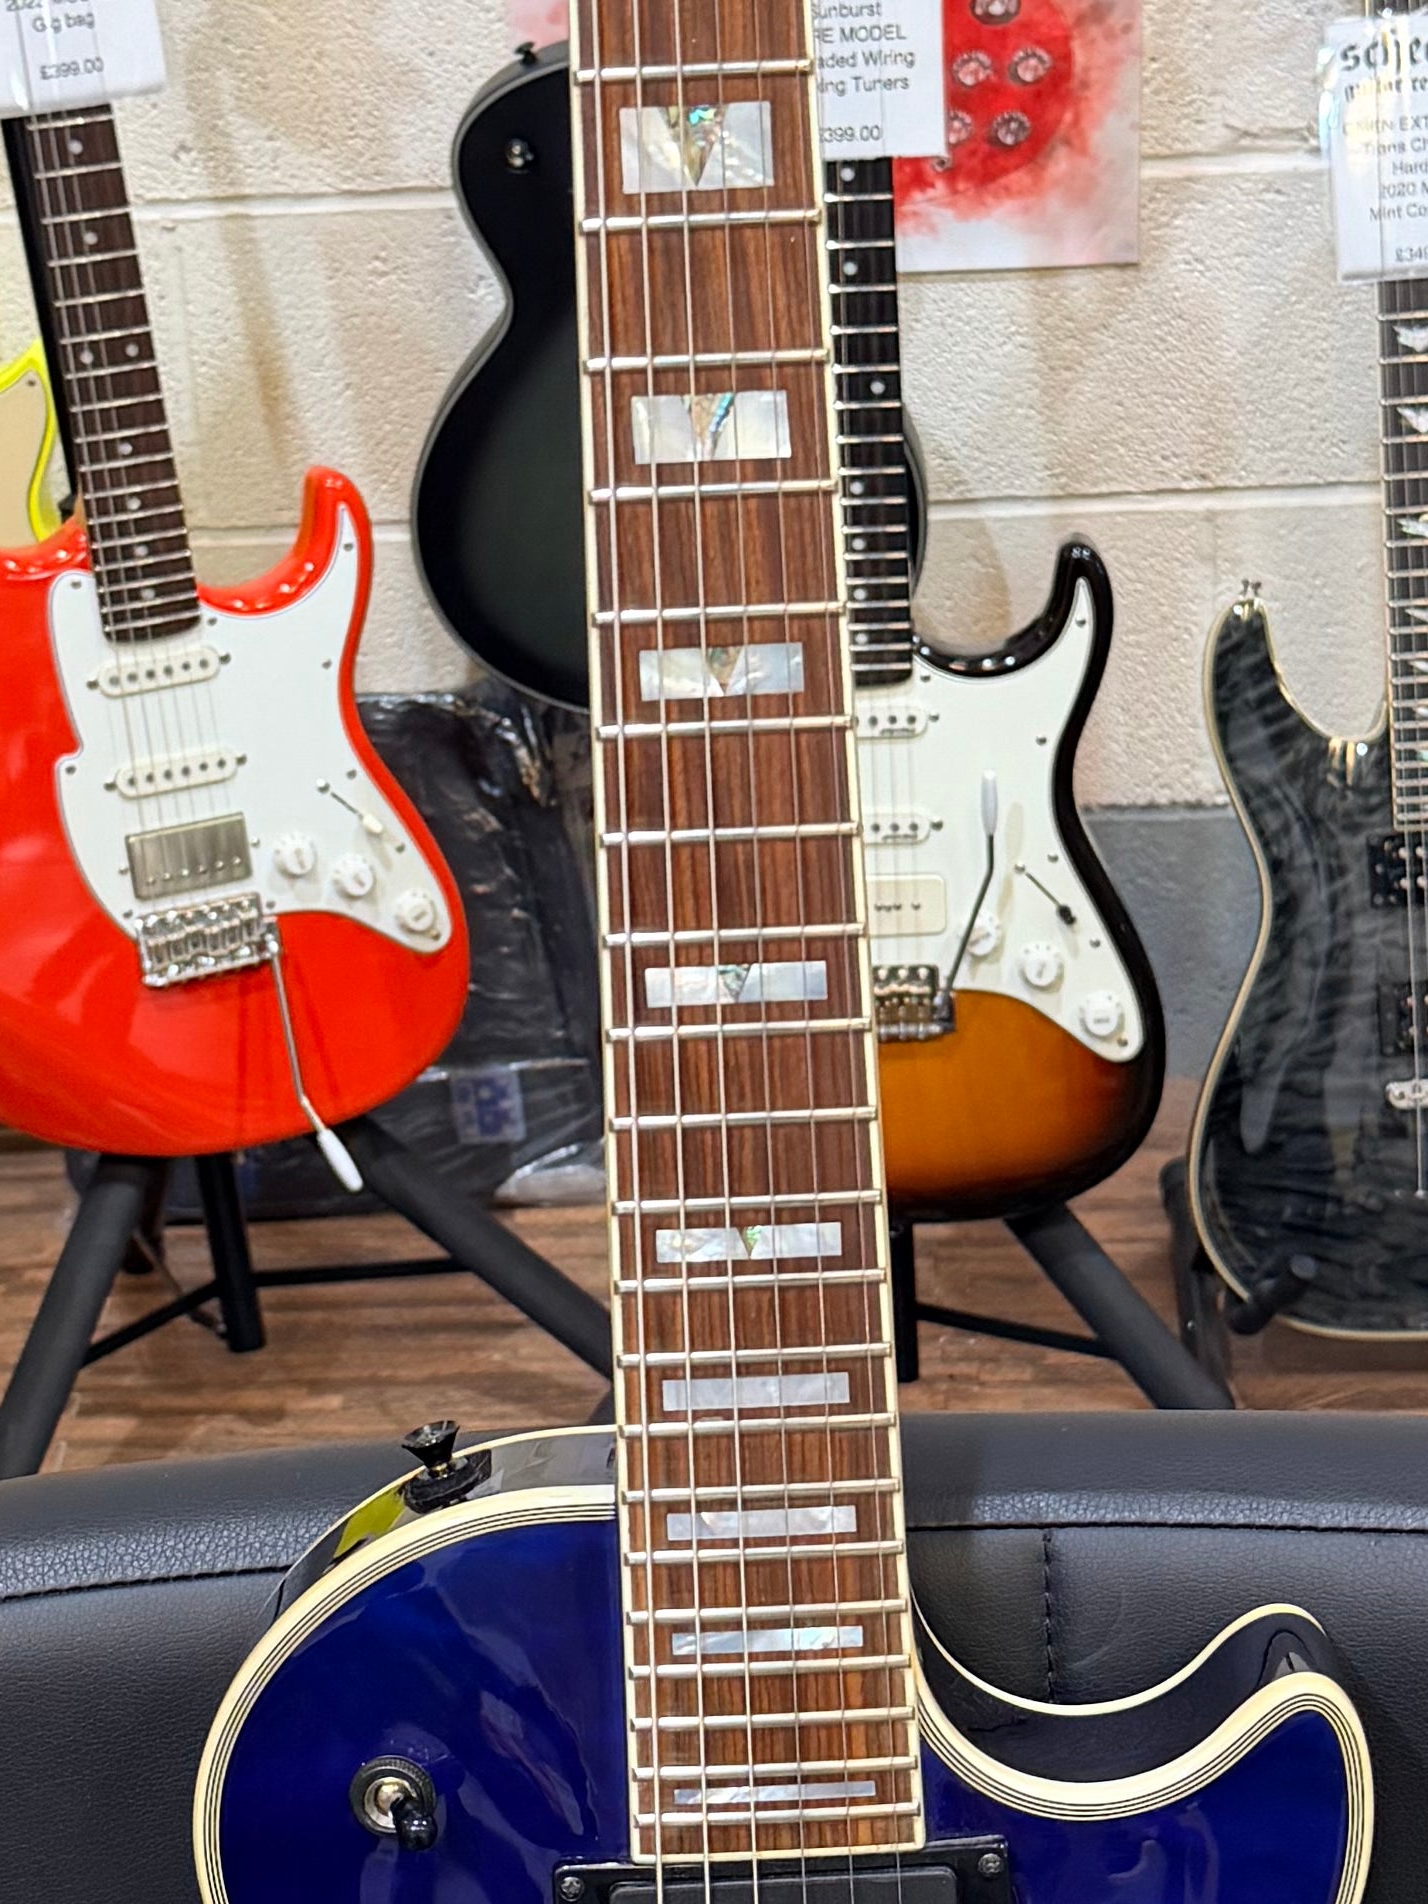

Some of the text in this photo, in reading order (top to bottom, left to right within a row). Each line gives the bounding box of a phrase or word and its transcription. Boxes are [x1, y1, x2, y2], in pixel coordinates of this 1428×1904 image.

[32, 16, 61, 34] Gg
[814, 23, 907, 44] RE MODEL
[818, 48, 915, 69] aded Wiring
[40, 57, 104, 80] £399.00
[853, 76, 910, 93] Tuners
[1369, 203, 1402, 221] Mint
